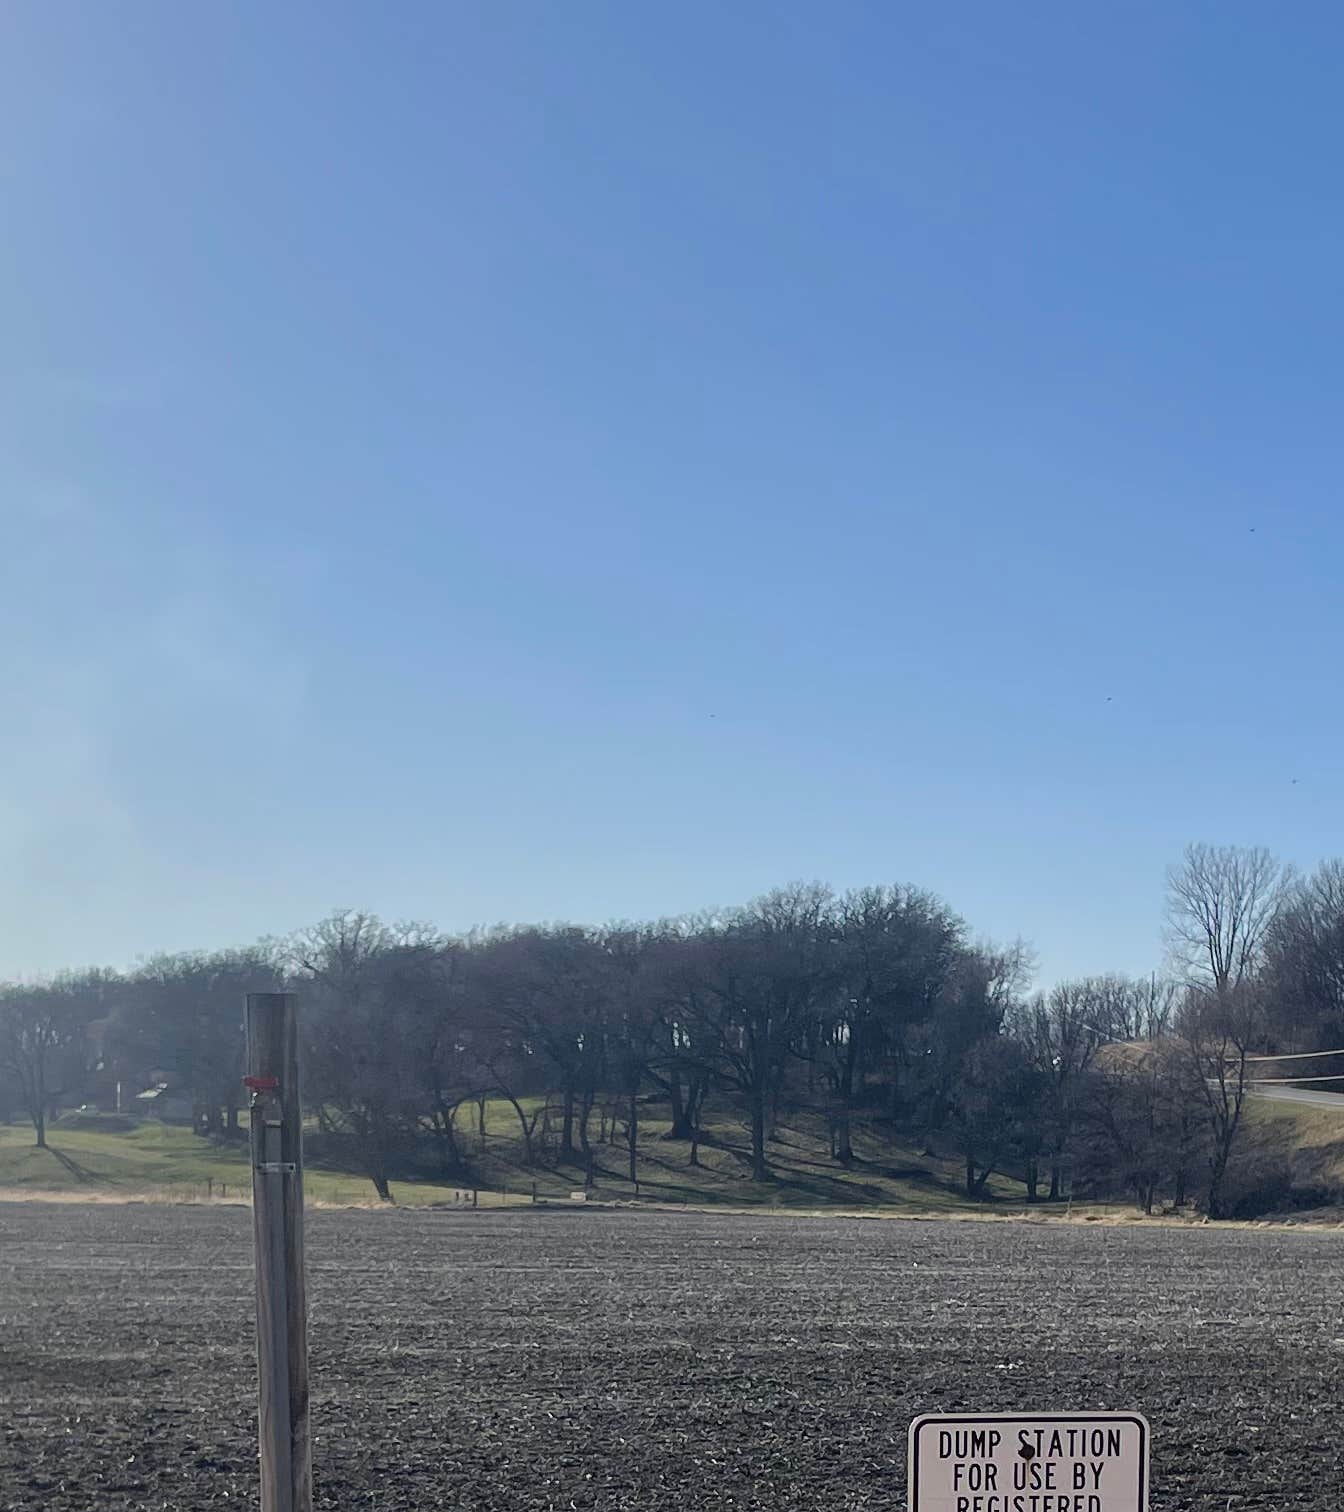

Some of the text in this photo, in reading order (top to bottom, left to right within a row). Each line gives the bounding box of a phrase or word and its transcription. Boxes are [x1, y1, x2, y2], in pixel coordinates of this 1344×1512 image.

[939, 1429, 1121, 1458] DUMP STATION
[954, 1462, 1104, 1491] FOR USE BY
